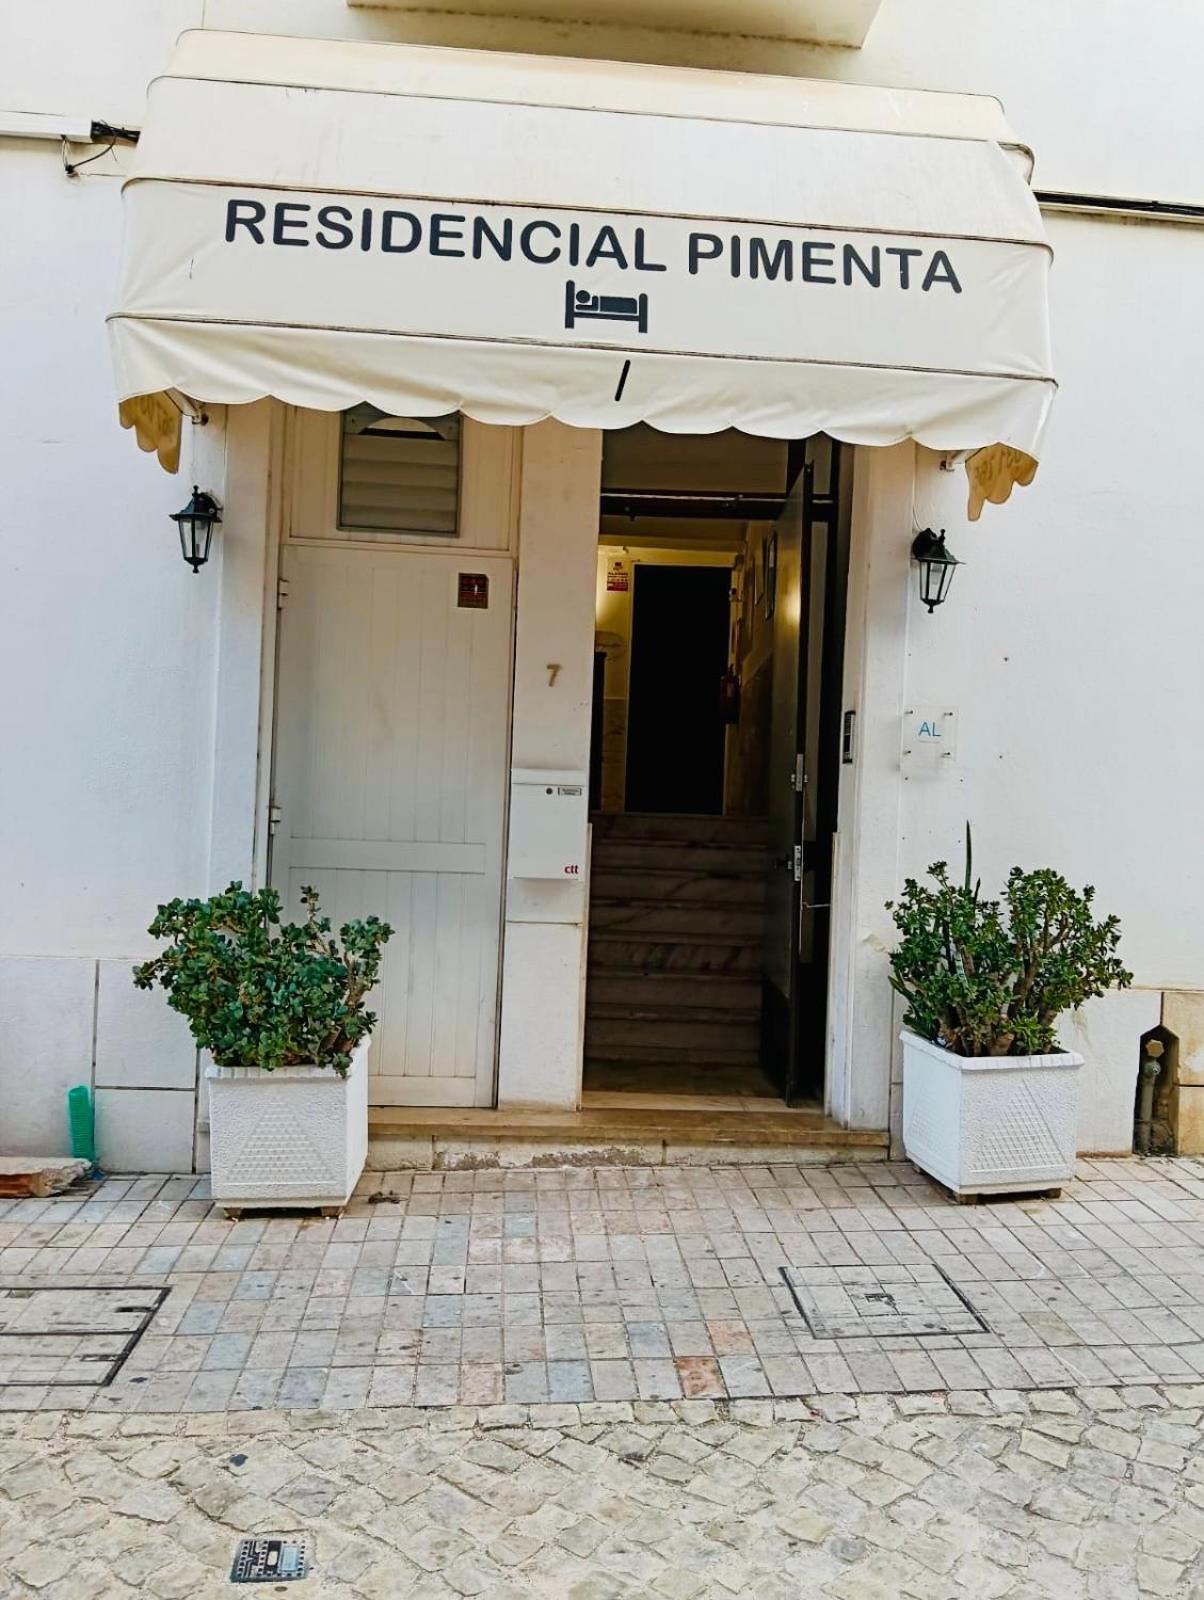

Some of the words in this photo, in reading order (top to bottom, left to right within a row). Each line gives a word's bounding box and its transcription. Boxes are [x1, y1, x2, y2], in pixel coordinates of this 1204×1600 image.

[225, 199, 667, 272] RESIDENCIAL
[688, 232, 962, 294] PIMENTA
[546, 663, 563, 687] 7
[918, 721, 942, 737] AL
[564, 864, 579, 875] ctt
